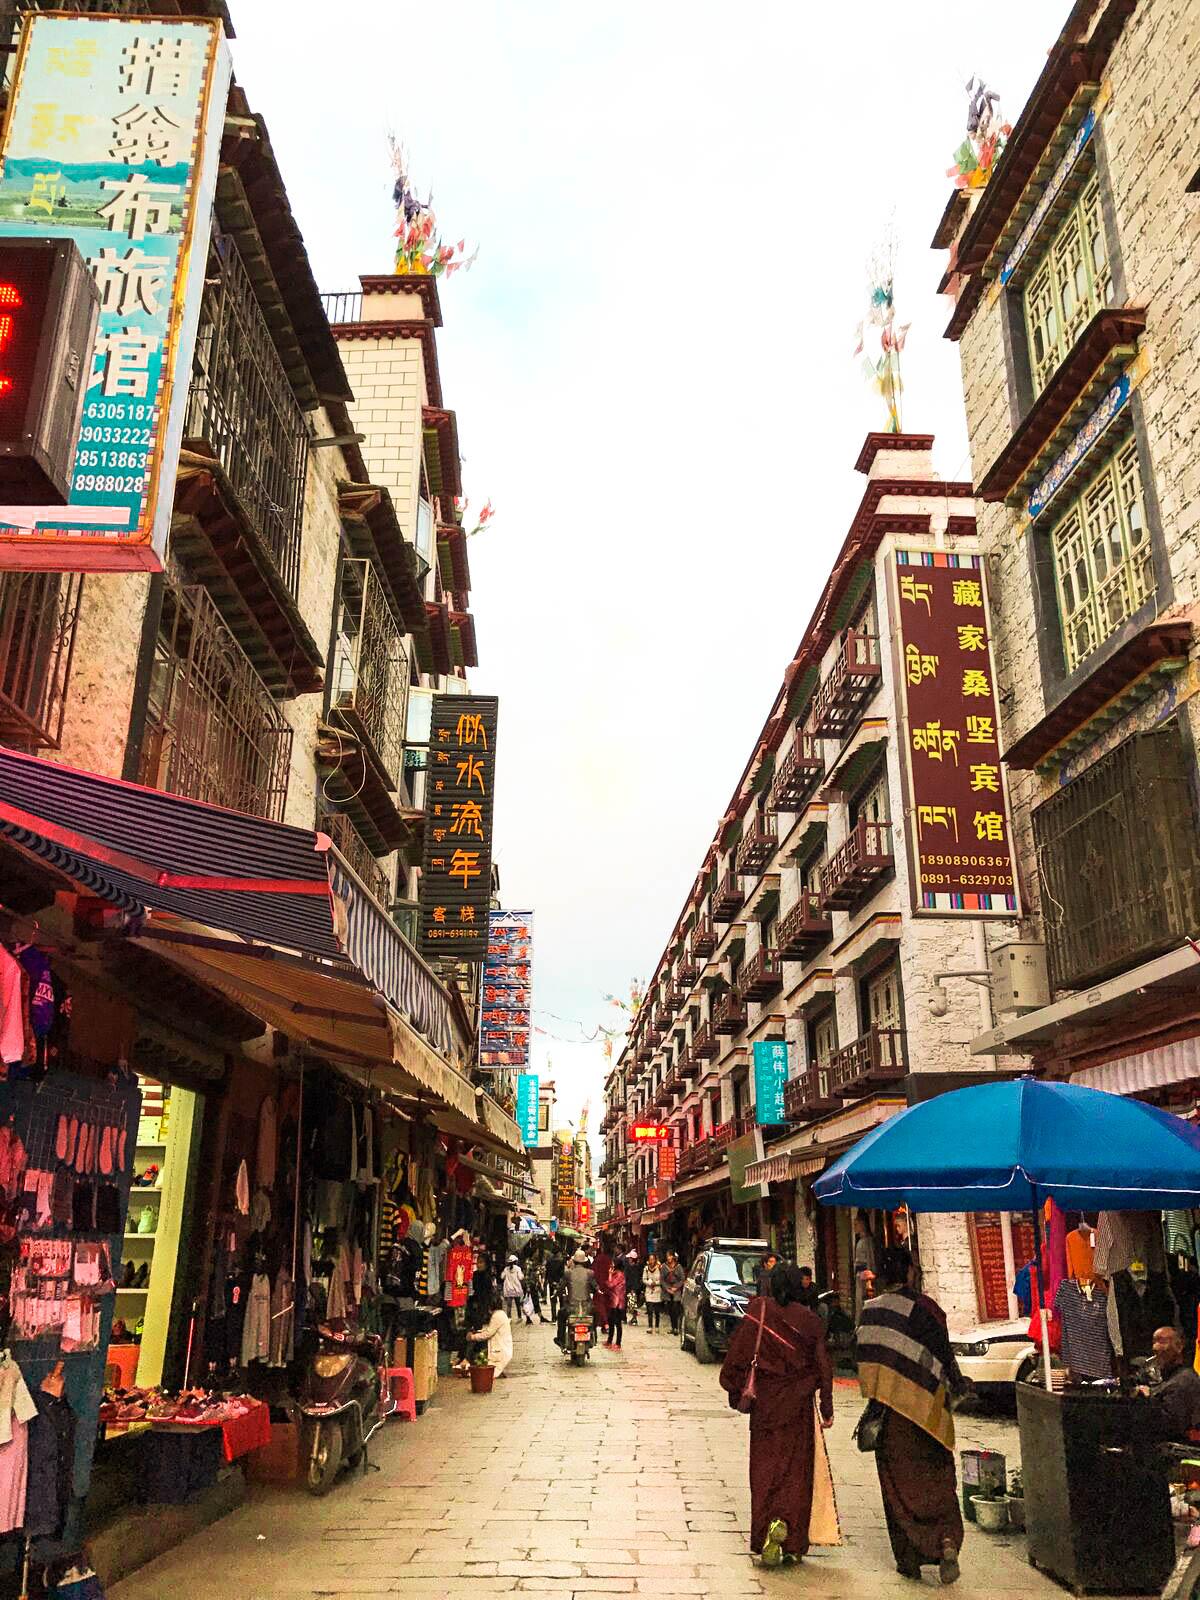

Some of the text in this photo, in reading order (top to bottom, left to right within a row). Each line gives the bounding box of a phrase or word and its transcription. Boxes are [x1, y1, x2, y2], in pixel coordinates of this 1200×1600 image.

[86, 37, 193, 397] 措翁布旅馆
[952, 579, 1004, 842] 藏家桑坚宾馆
[448, 712, 488, 889] 似水流年
[920, 854, 1011, 867] 18908906367
[921, 873, 1013, 886] 0891-6329703
[432, 905, 475, 925] 客栈
